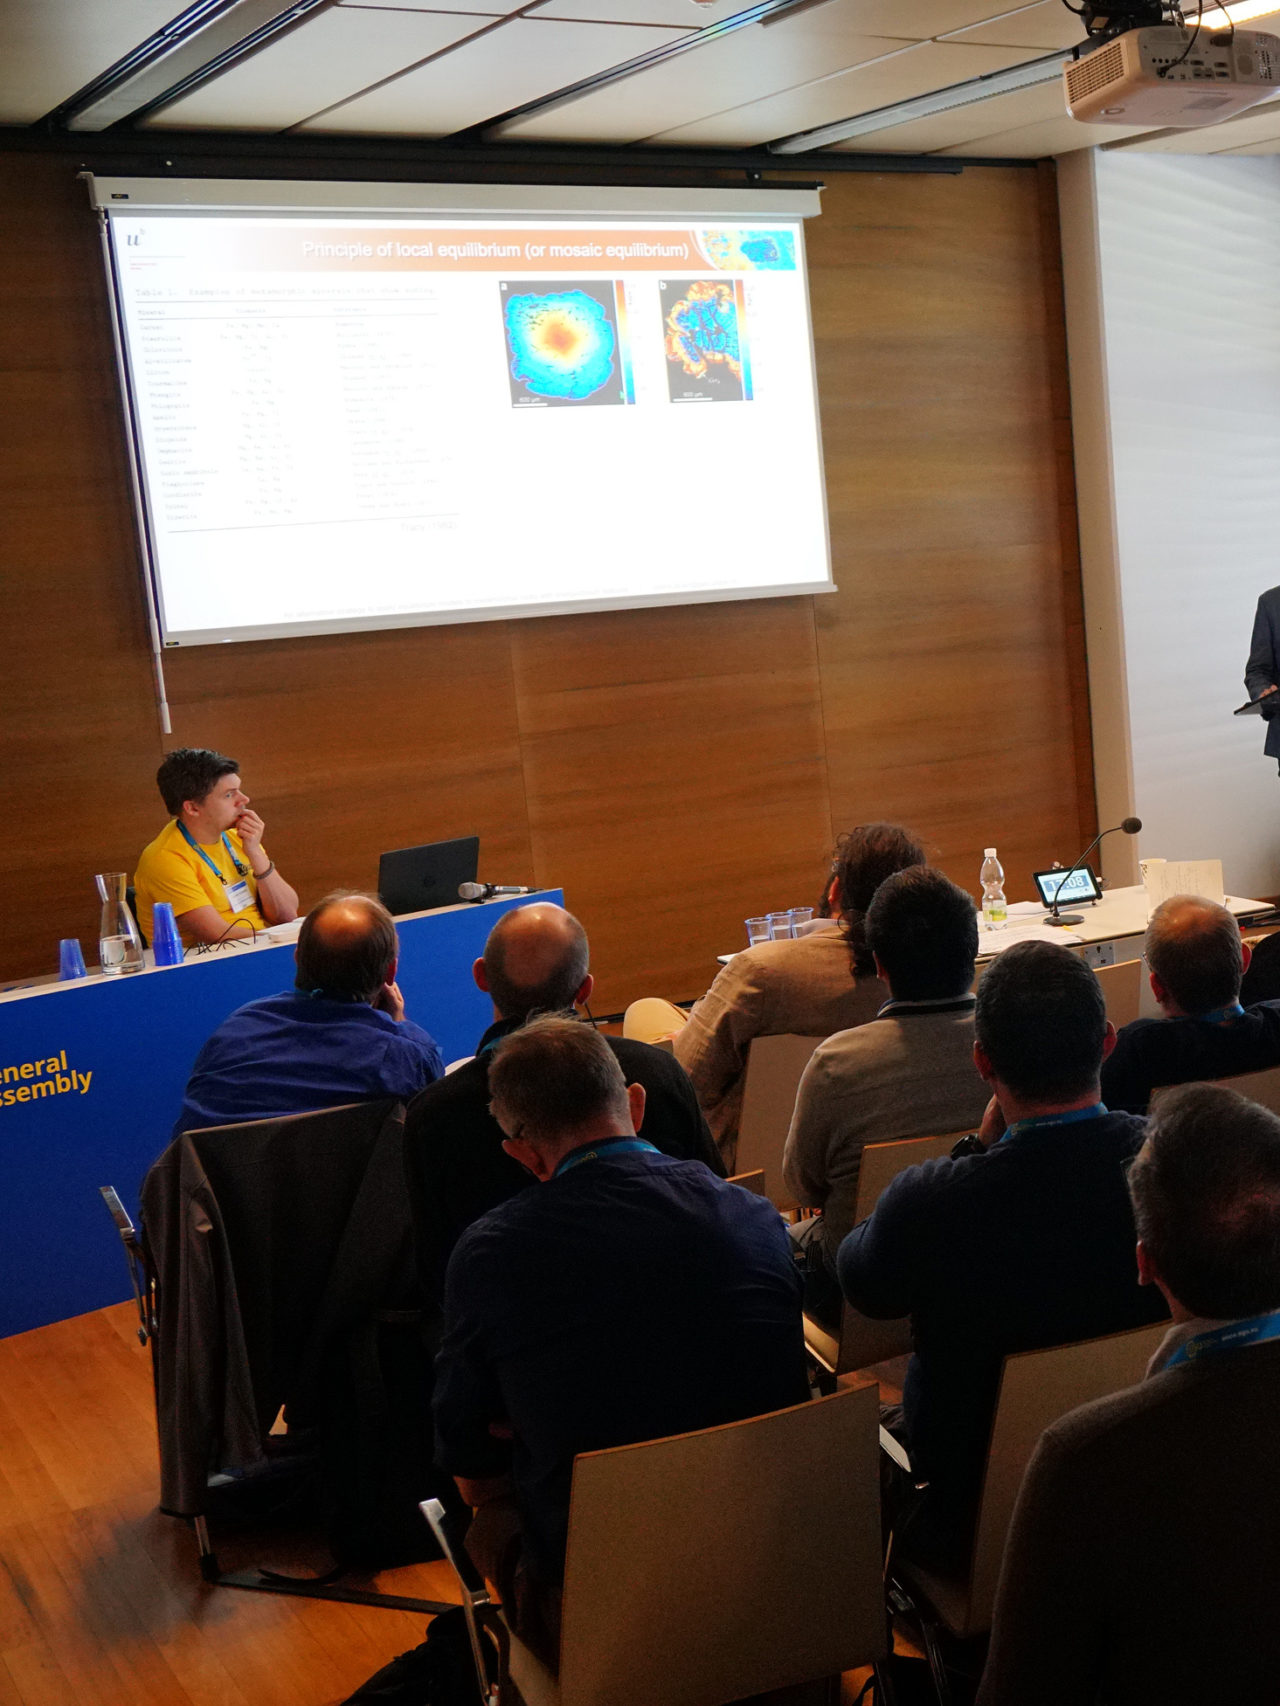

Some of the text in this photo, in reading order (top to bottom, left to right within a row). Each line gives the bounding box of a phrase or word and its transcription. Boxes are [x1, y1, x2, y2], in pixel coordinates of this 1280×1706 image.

[303, 241, 689, 261] Principle of local equilibrium (or mosaic equilibrium)
[0, 1049, 68, 1085] neral
[0, 1069, 93, 1108] sembly
